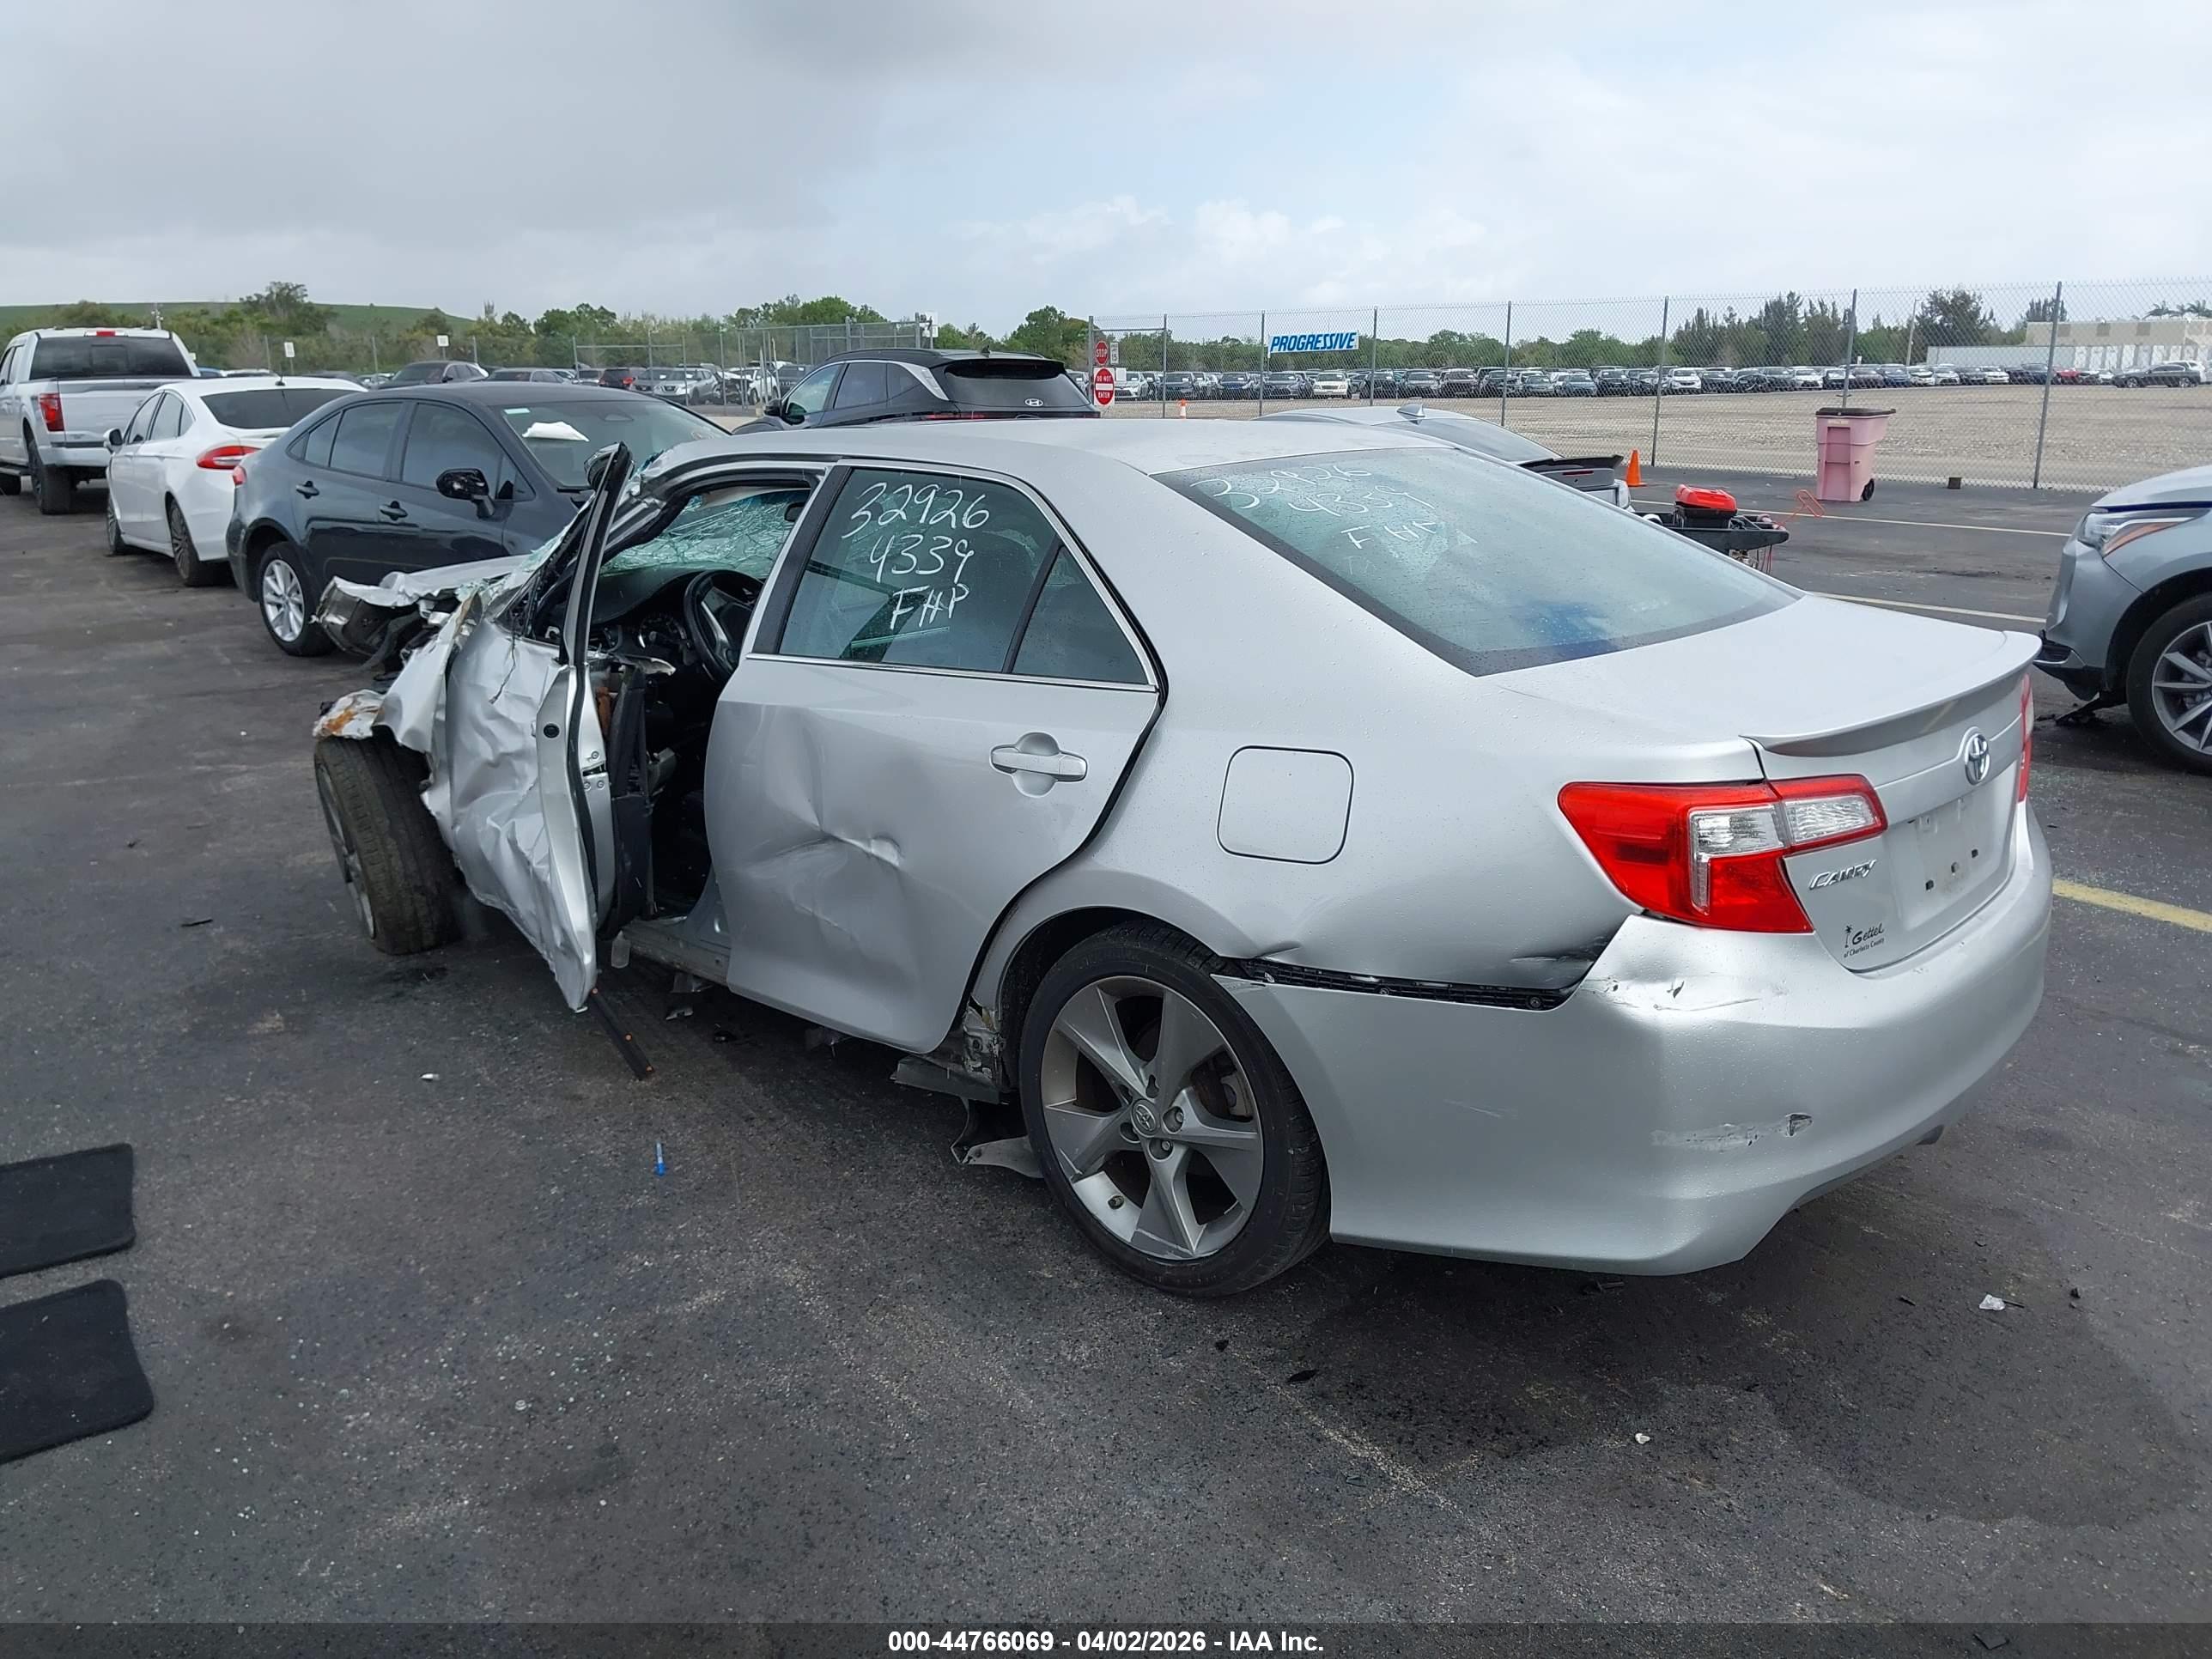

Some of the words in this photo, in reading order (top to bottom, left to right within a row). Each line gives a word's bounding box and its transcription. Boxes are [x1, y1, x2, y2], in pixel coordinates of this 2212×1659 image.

[1096, 349, 1108, 358] STOP
[1271, 332, 1357, 352] PROGRESSIVE
[1189, 465, 1372, 509] 32926
[1288, 485, 1435, 517] 4339
[842, 482, 989, 539] 32926
[870, 534, 975, 584] 4339
[890, 583, 969, 629] FHP
[1808, 859, 1877, 890] CAMRY
[1851, 922, 1885, 945] Gettel
